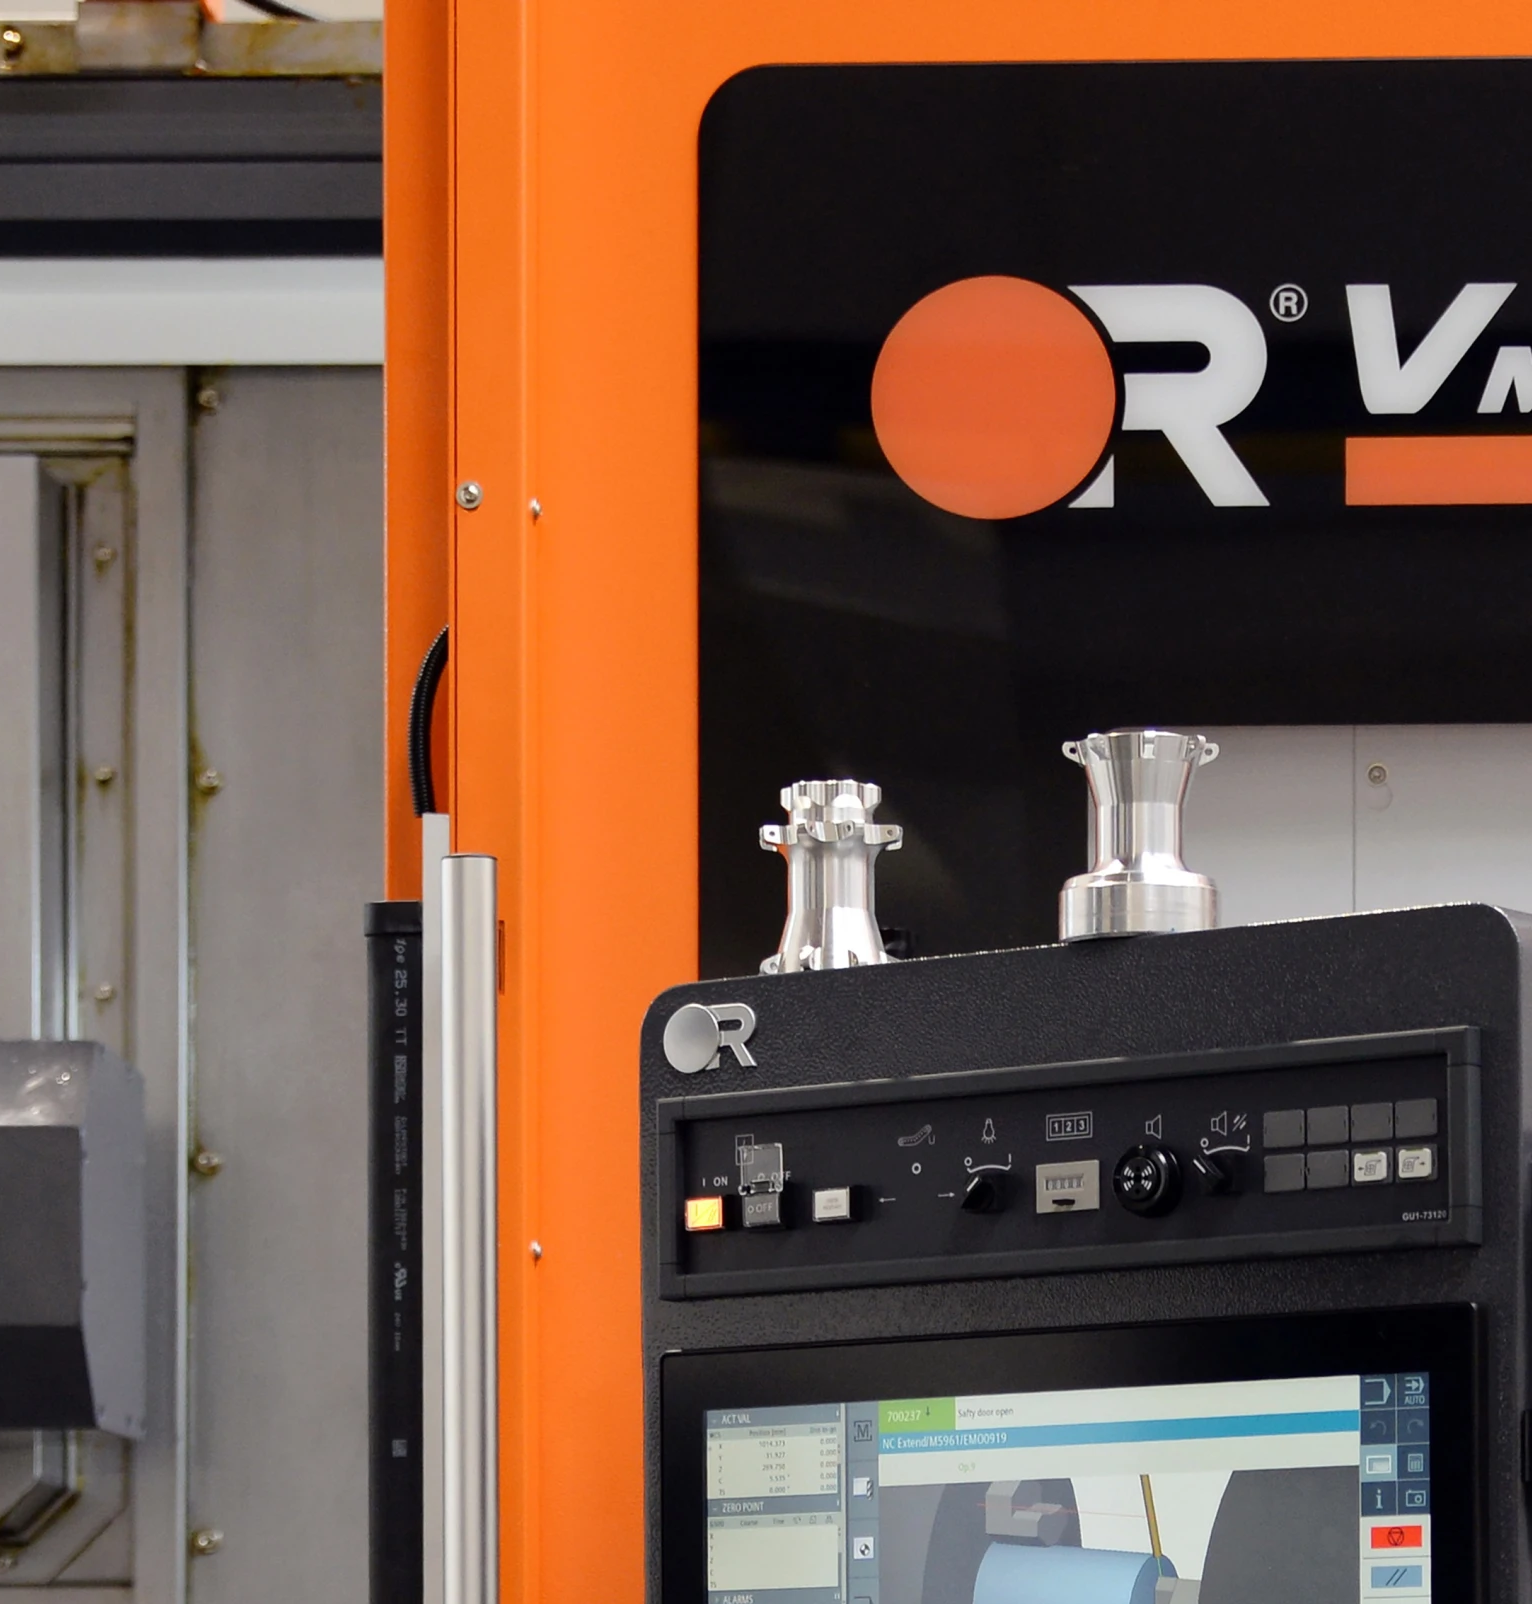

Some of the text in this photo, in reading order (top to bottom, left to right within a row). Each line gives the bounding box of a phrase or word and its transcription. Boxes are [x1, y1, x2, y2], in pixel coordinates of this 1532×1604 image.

[394, 969, 408, 1017] 25.30
[713, 1176, 728, 1187] ON
[756, 1202, 773, 1213] OFF
[1404, 1396, 1425, 1405] AUTO
[721, 1414, 751, 1425] ACT VAL
[888, 1407, 1014, 1423] 700237 Safty door open
[883, 1438, 895, 1450] NC
[722, 1501, 765, 1513] ZERO POINT
[723, 1594, 754, 1604] ALARMS
